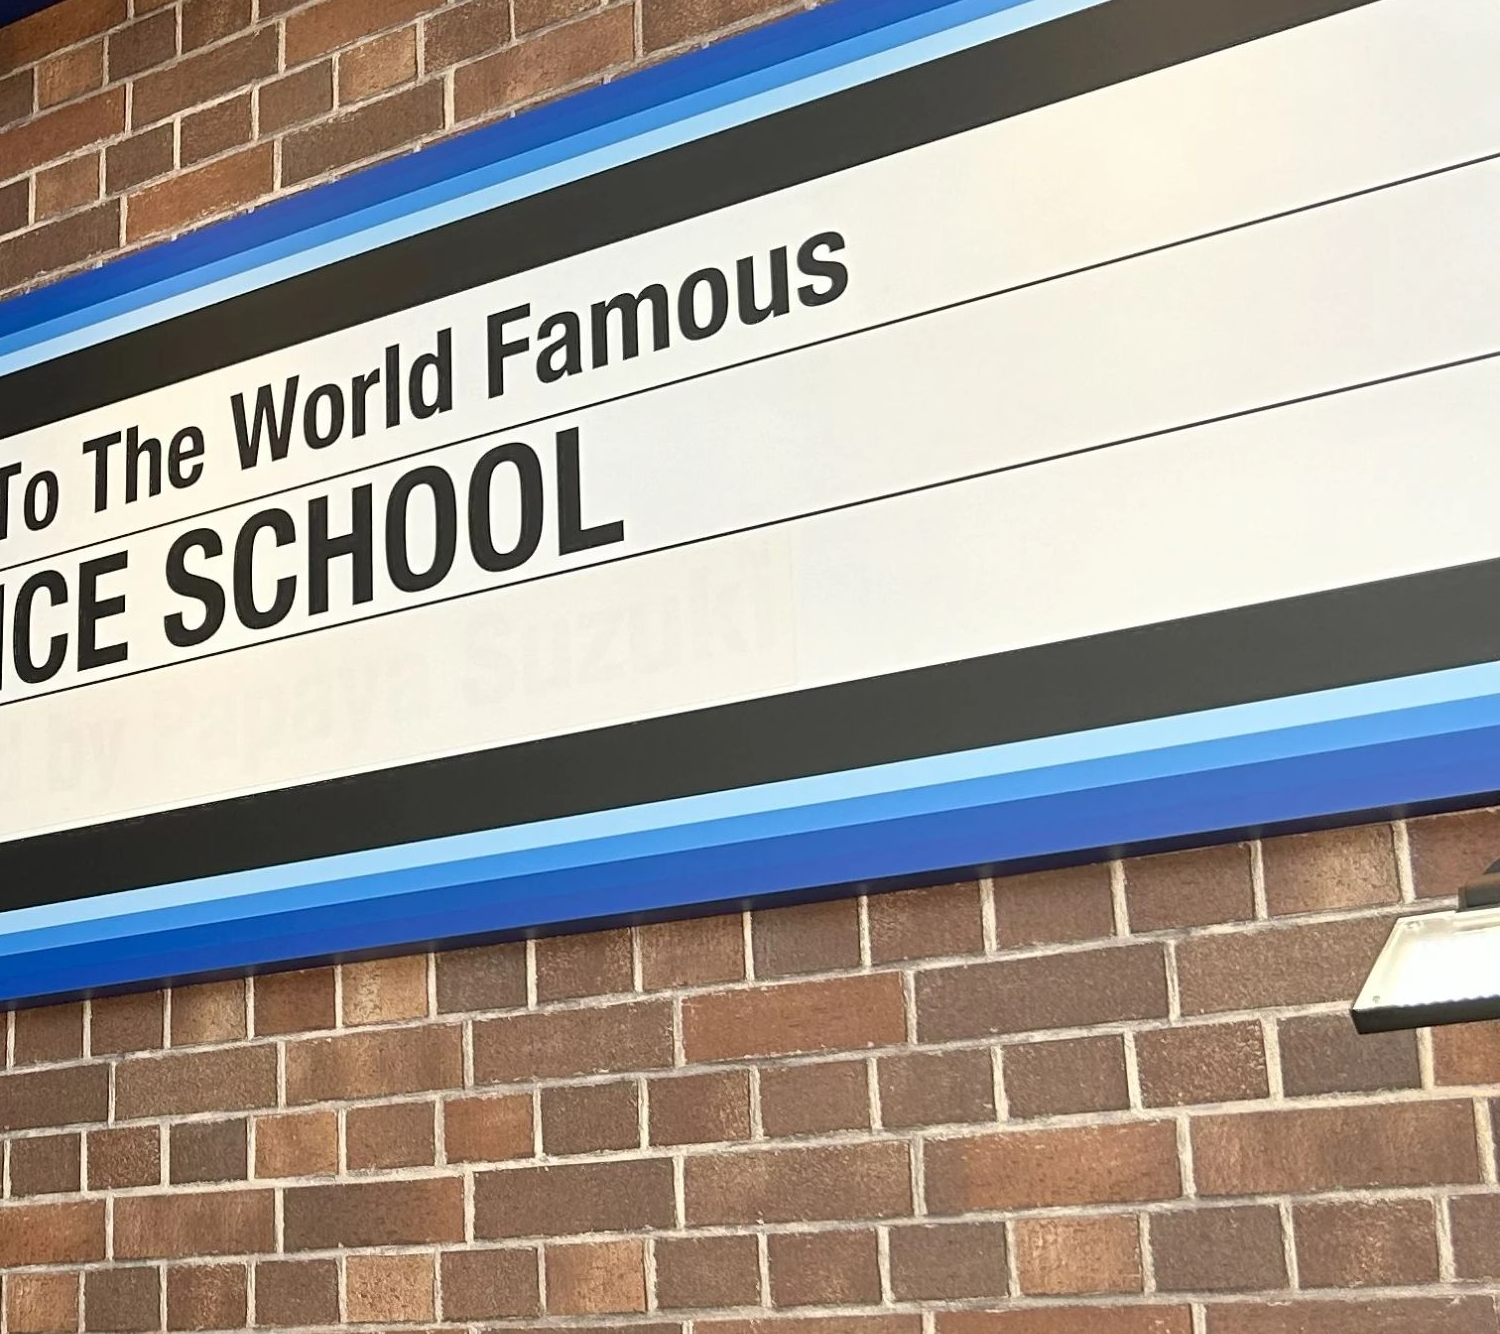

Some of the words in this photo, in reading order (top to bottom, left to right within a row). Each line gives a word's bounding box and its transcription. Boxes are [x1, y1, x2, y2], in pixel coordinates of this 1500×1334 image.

[82, 419, 207, 515] The
[230, 327, 453, 473] World
[486, 230, 850, 400] Famous
[162, 425, 625, 650] SCHOOL
